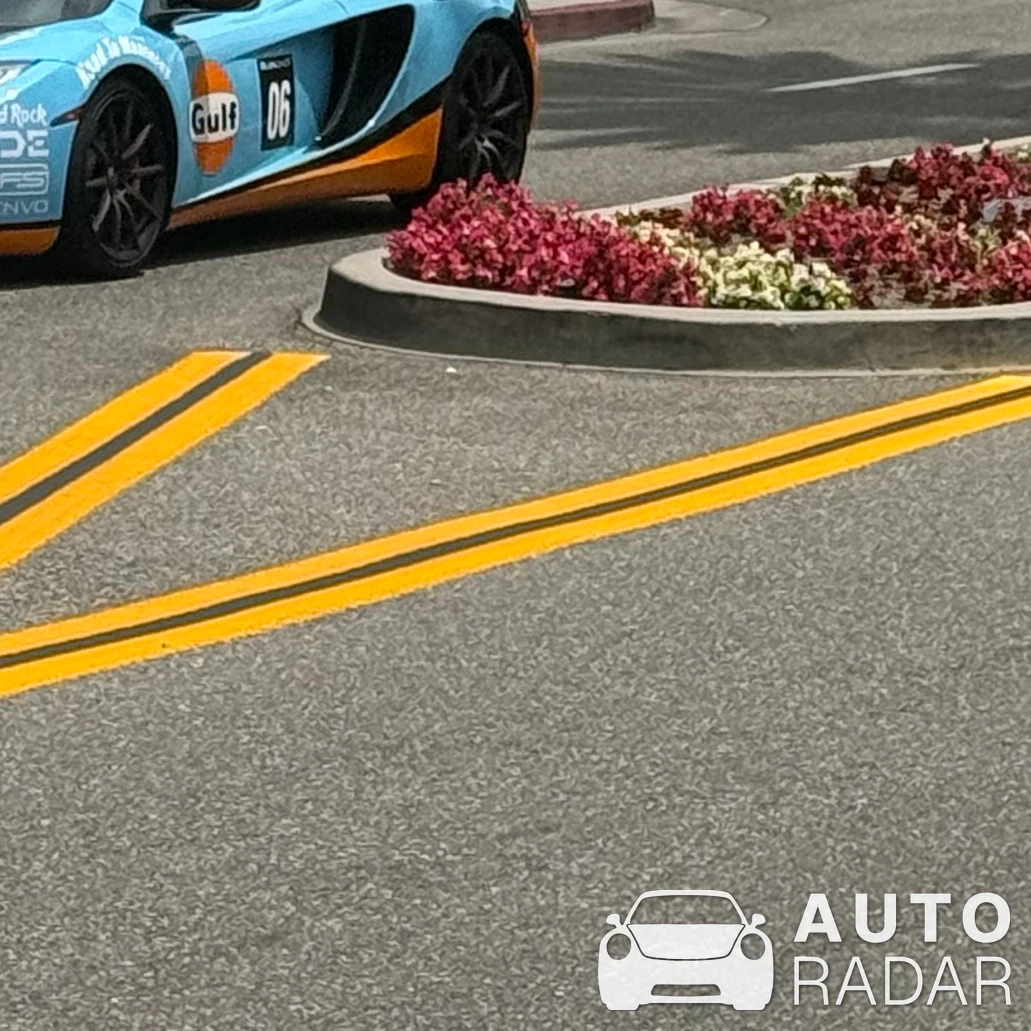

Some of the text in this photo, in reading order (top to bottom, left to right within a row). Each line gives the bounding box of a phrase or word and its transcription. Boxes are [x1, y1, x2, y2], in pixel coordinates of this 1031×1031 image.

[10, 103, 49, 128] Rock
[191, 101, 237, 136] Gulf
[267, 79, 291, 141] 06
